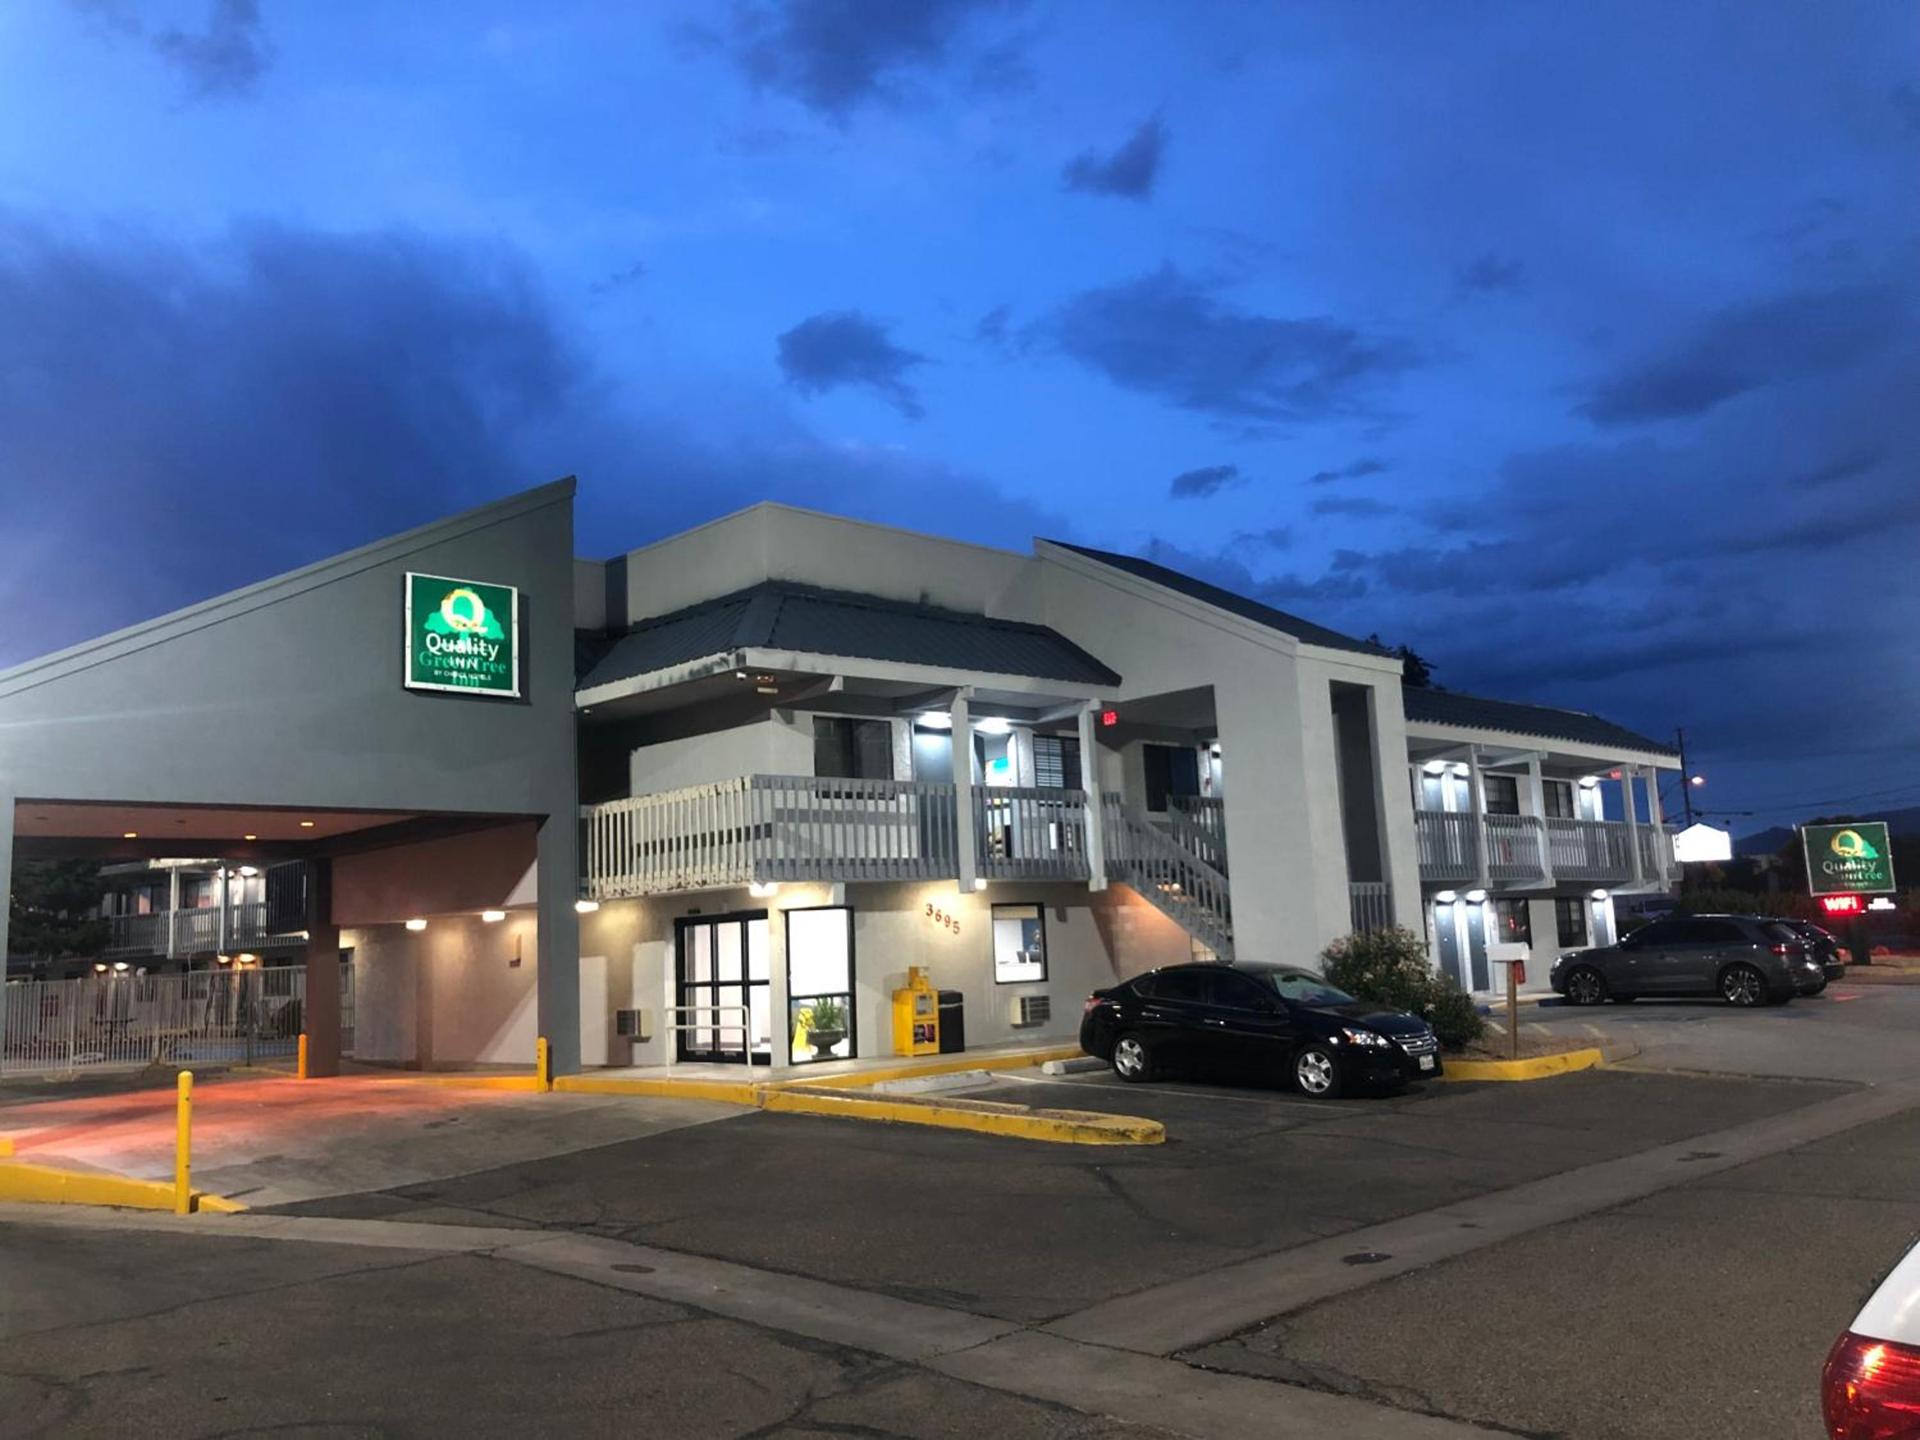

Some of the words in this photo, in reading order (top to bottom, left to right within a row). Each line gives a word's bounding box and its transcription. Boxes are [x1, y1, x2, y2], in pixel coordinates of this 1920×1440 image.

[426, 632, 499, 661] Quality
[1822, 860, 1876, 874] Quality
[926, 903, 961, 935] 3695
